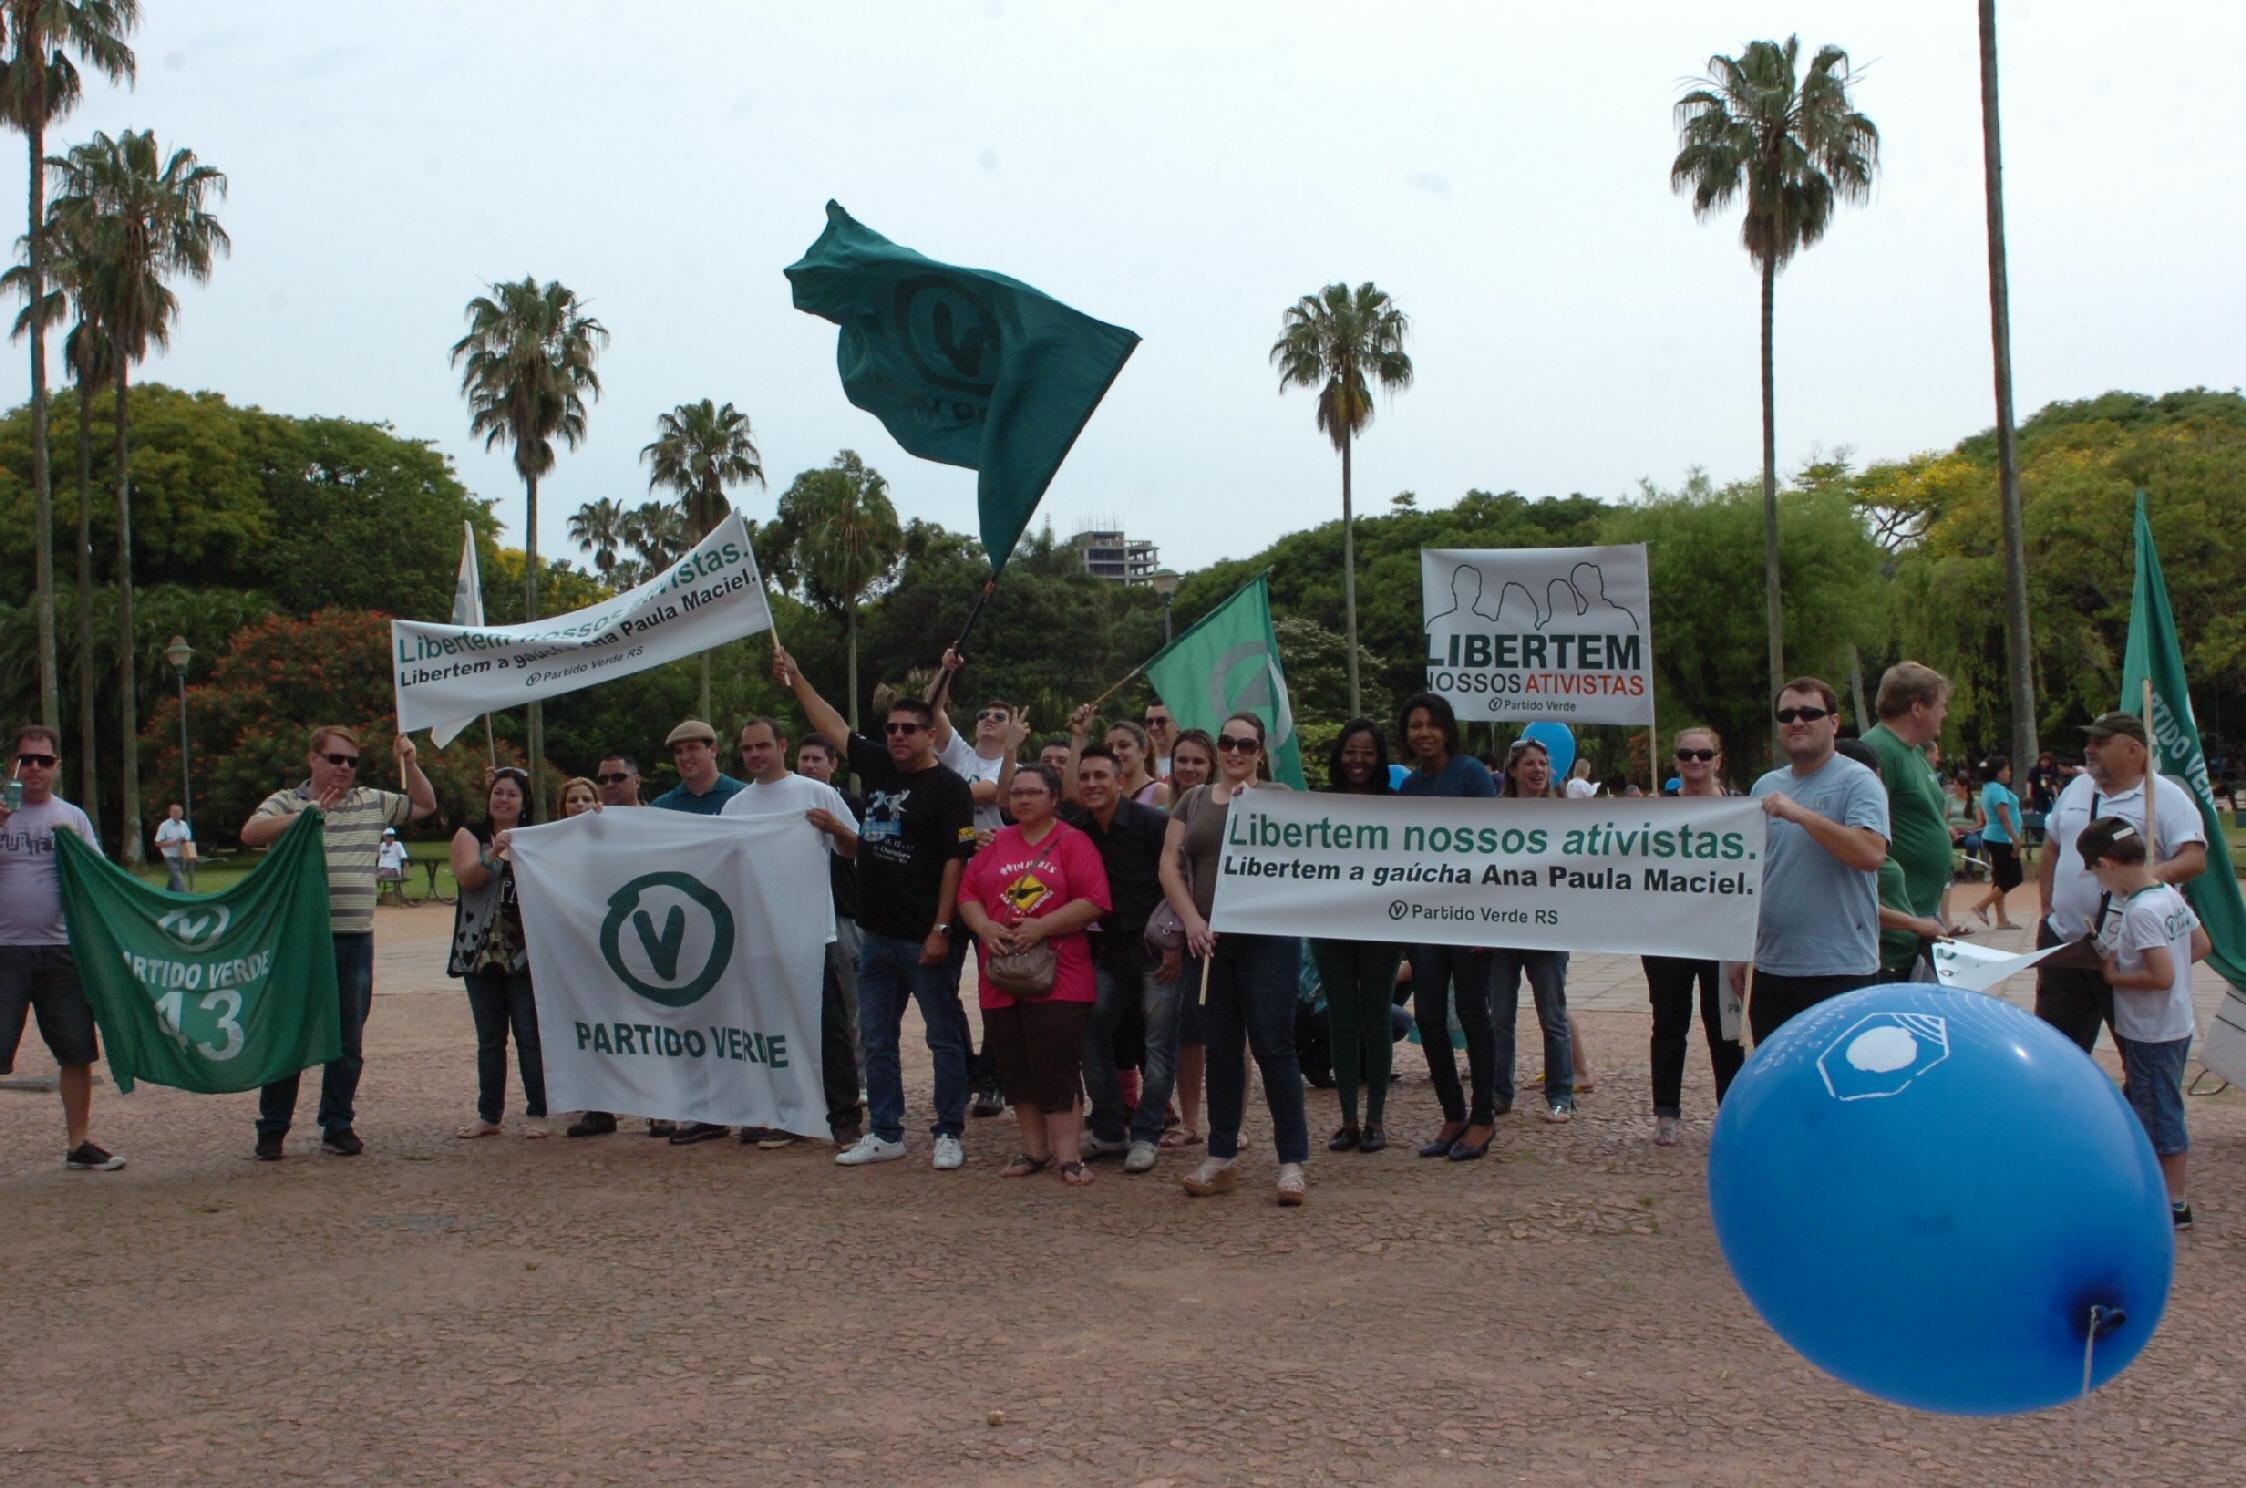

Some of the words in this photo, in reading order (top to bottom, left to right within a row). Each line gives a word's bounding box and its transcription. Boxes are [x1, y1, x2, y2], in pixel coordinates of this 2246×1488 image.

[399, 631, 510, 663] Libertem
[630, 542, 749, 611] istas.
[401, 660, 491, 688] Libertem
[497, 658, 509, 669] a
[513, 642, 579, 669] gaúc
[619, 605, 679, 637] Paula
[680, 568, 756, 612] Maciel.
[543, 664, 588, 682] Partido
[591, 652, 623, 669] Verde
[627, 646, 644, 659] RS
[1426, 633, 1641, 670] LIBERTEM
[1524, 673, 1644, 696] ATIVISTAS
[1504, 699, 1543, 712] Partido
[1546, 700, 1576, 712] Verde
[1229, 814, 1388, 850] Libertem
[1404, 824, 1548, 854] nossos
[1561, 822, 1756, 860] ativistas.
[1224, 856, 1340, 880] Libertem
[1349, 865, 1363, 880] a
[1371, 862, 1471, 886] gaúcha
[1481, 864, 1537, 887] Ana
[1549, 866, 1632, 890] Paula
[1643, 868, 1753, 895] Maciel.
[1412, 904, 1475, 920] Partido
[1481, 907, 1528, 924] Verde
[1535, 910, 1558, 925] RS
[124, 951, 202, 990] RTIDO
[209, 950, 270, 989] VERDE
[575, 1021, 706, 1057] PARTIDO
[710, 1026, 789, 1068] VERDE
